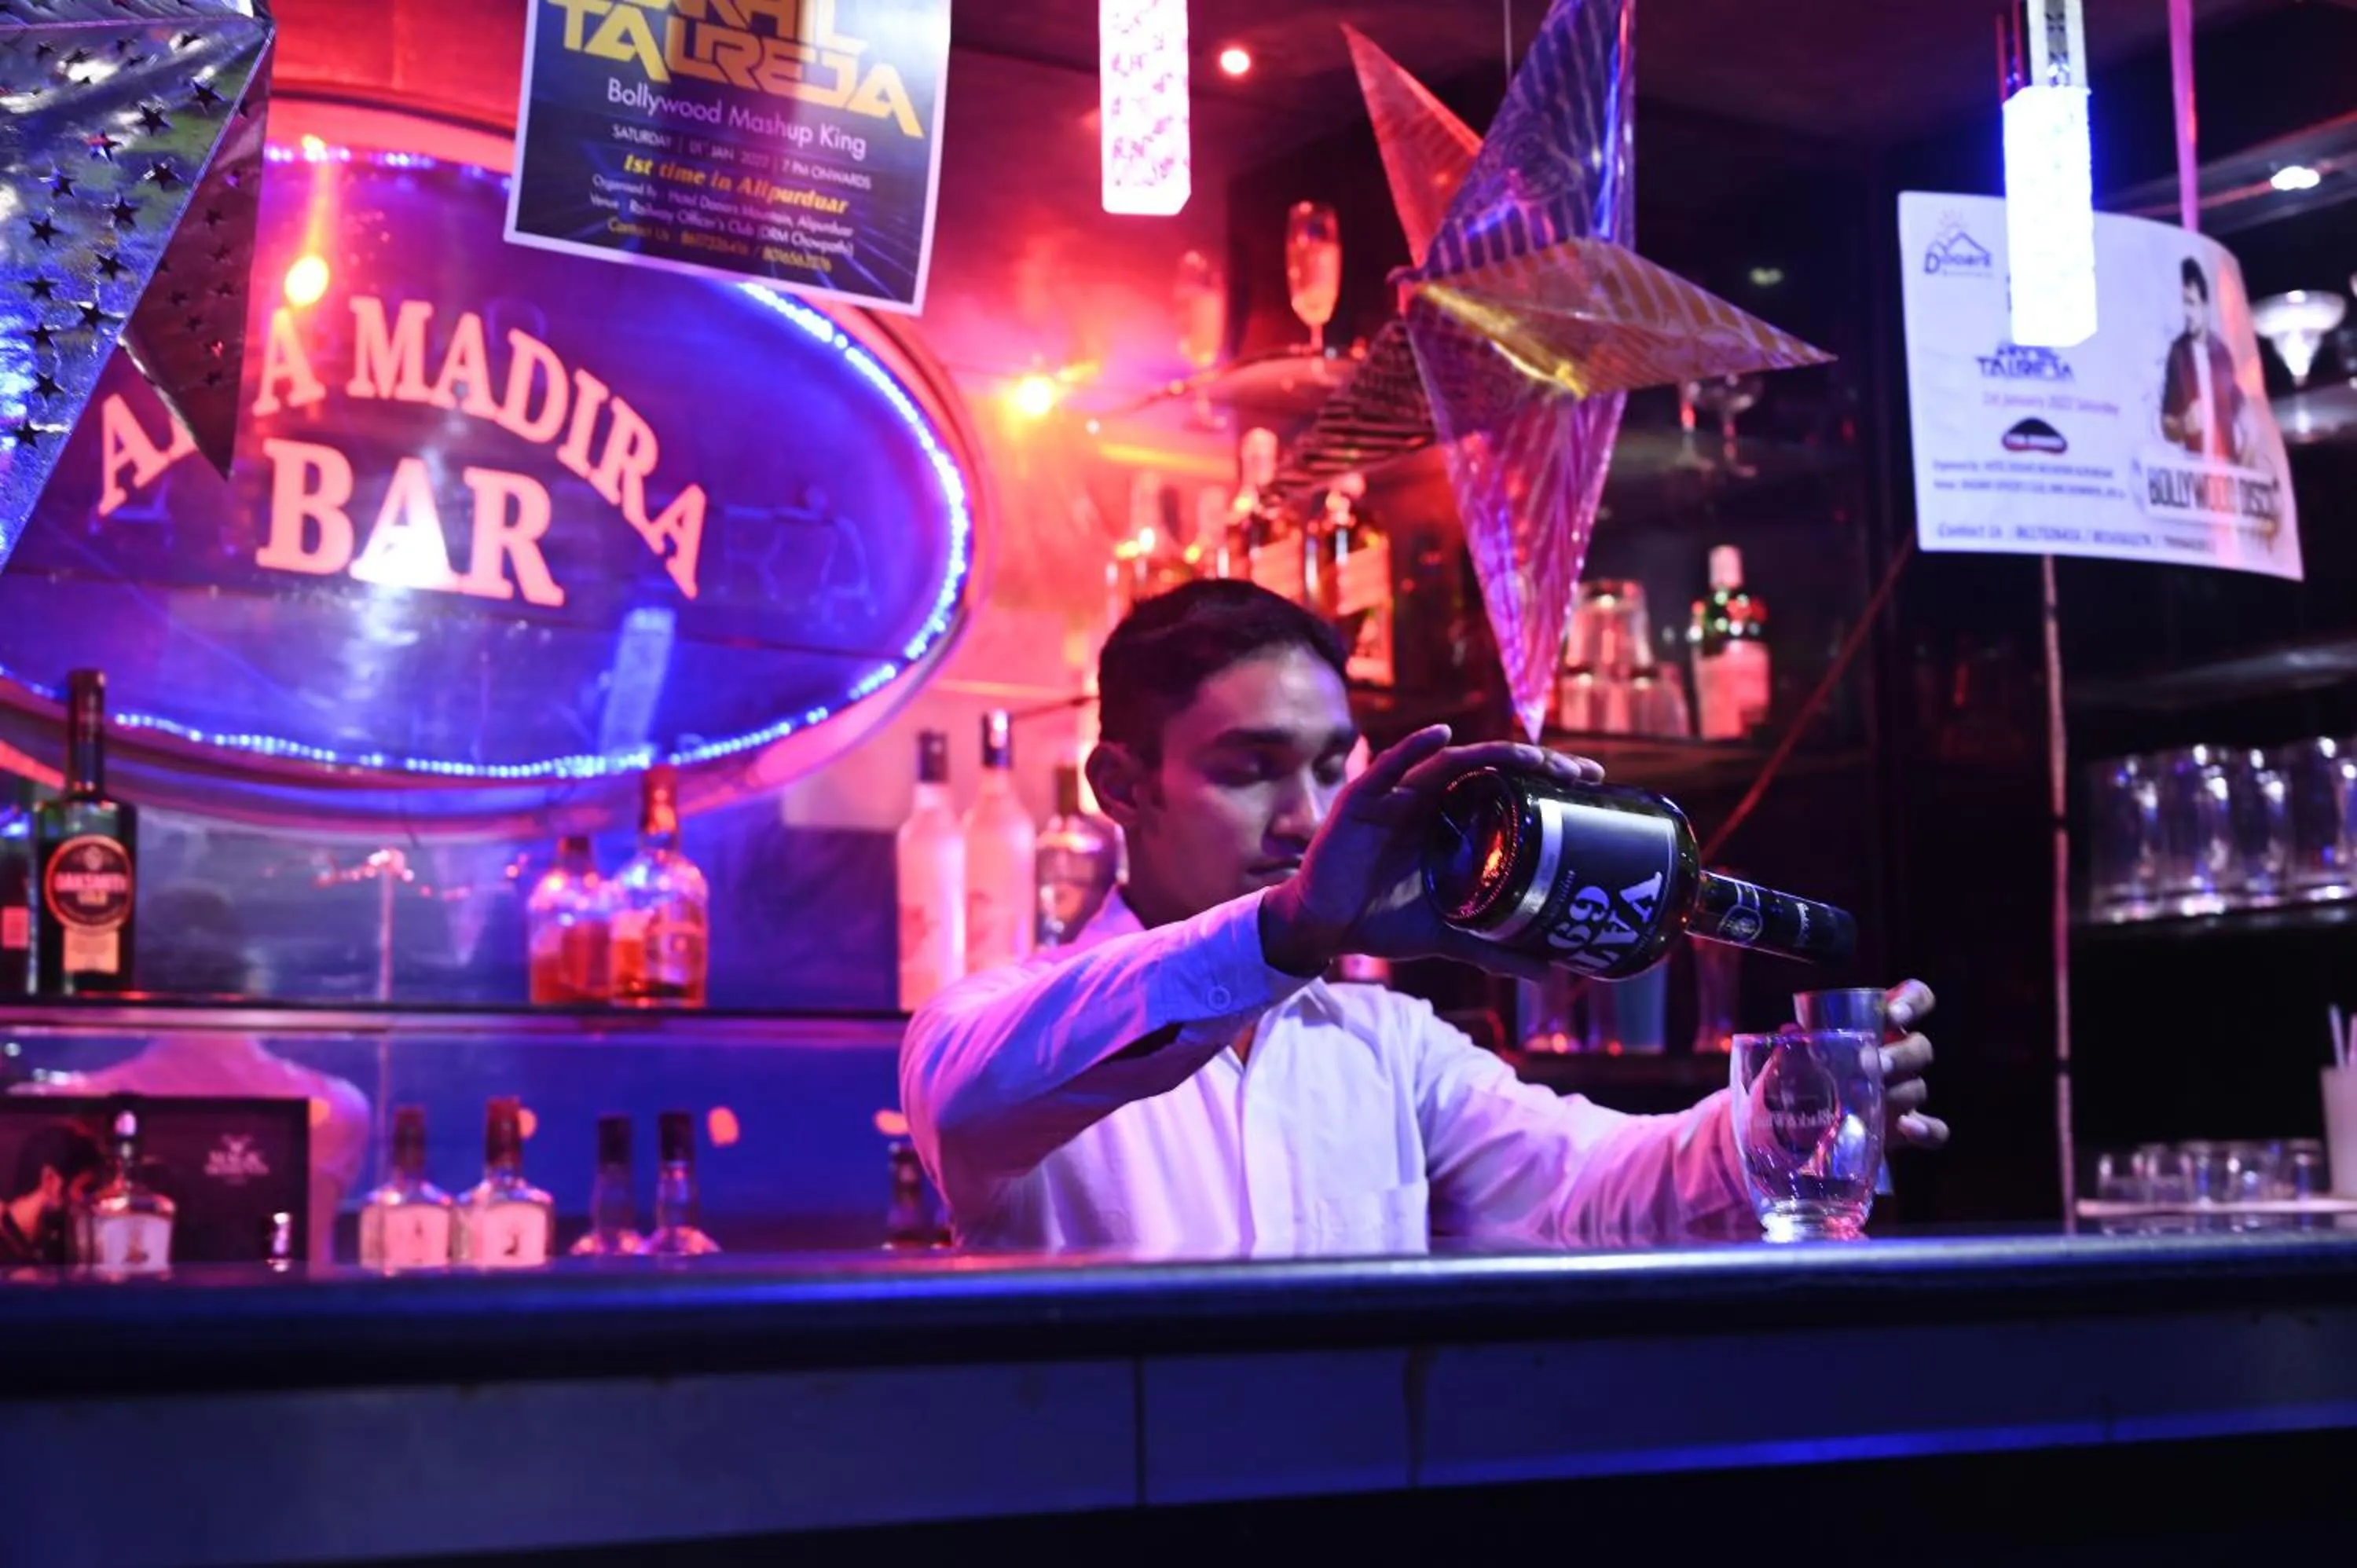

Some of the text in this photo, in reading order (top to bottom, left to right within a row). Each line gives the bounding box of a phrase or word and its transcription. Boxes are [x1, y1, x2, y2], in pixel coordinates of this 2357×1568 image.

[547, 0, 924, 139] TALREJA
[607, 77, 867, 162] Bollywood Mashup King
[611, 123, 673, 148] SATURDAY
[811, 165, 871, 189] ONWARDS
[659, 163, 706, 185] time
[710, 169, 732, 190] in
[737, 176, 849, 214] Alipurduar
[346, 297, 707, 600] MADIRA
[255, 438, 565, 606] BAR
[1547, 886, 1610, 949] 69
